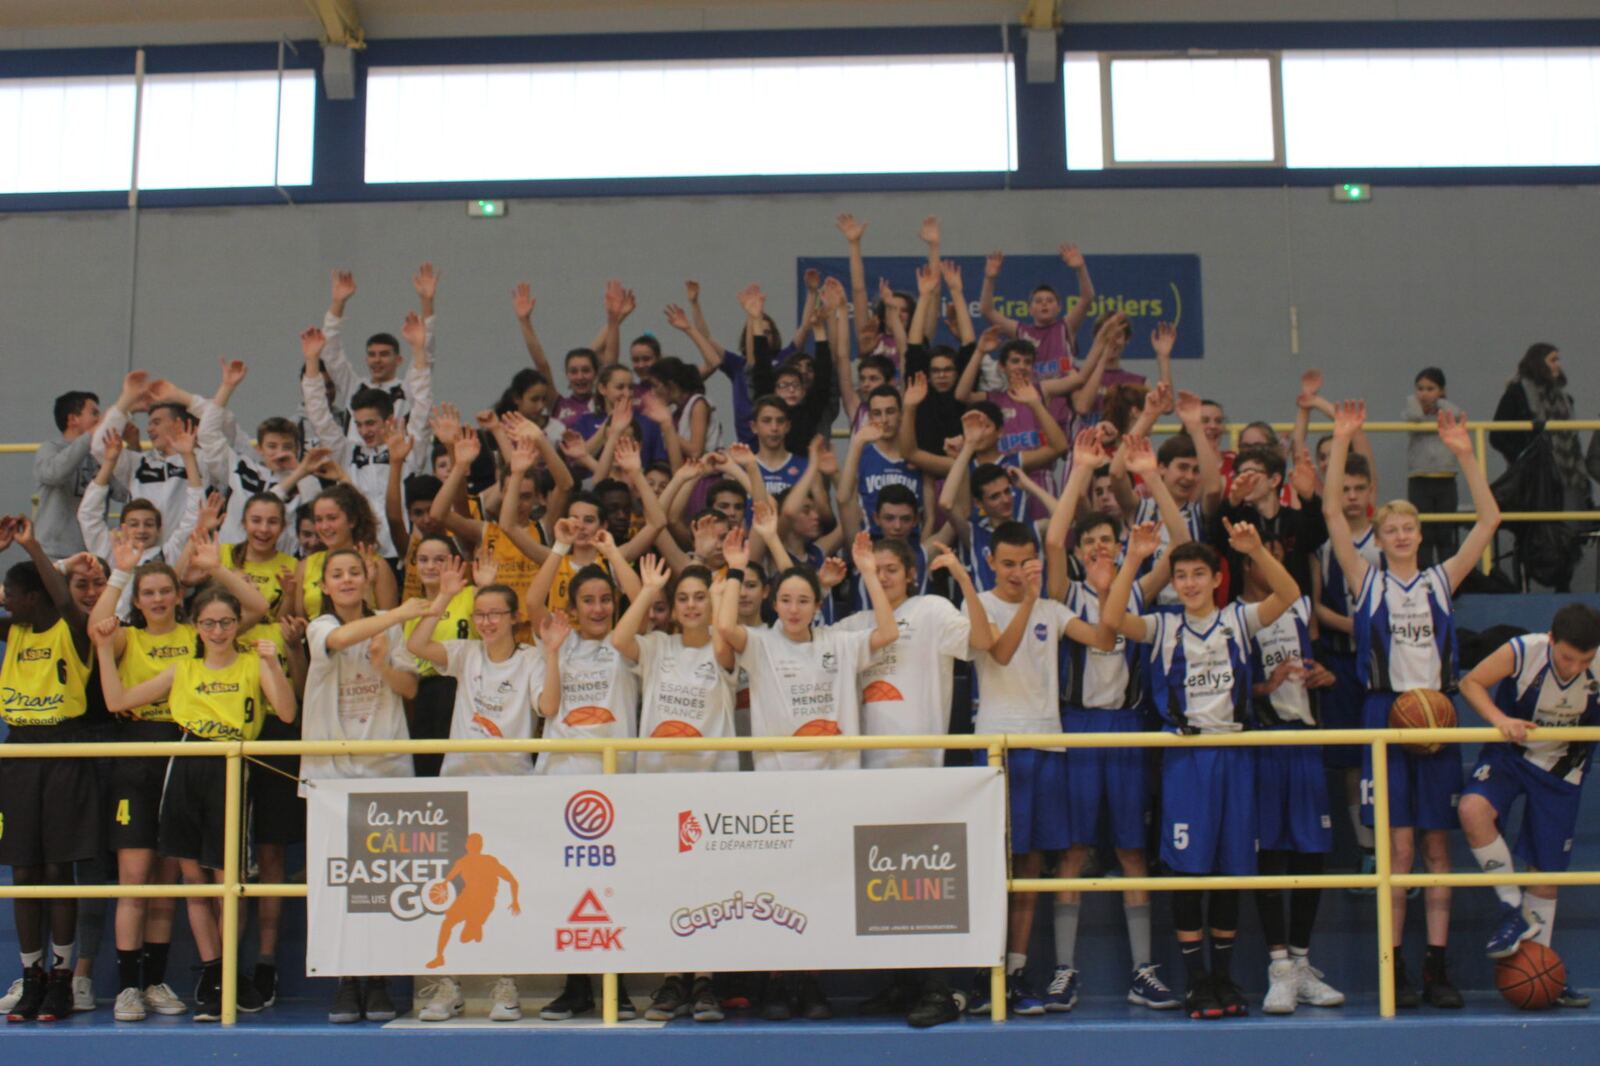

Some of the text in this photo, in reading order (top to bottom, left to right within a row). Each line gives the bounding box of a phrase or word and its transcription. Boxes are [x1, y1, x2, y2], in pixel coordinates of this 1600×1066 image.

[57, 658, 67, 685] 6
[1184, 670, 1232, 689] ealys
[660, 682, 707, 698] ESPACE
[244, 697, 255, 724] 9
[657, 704, 704, 720] FRANCE
[1472, 764, 1492, 781] 4
[115, 799, 130, 826] 4
[367, 801, 449, 826] la mie
[704, 809, 795, 835] VENDÉE
[366, 827, 449, 853] CÂLINE
[705, 838, 795, 851] LE DÉPARTEMENT
[1173, 823, 1189, 850] 5
[564, 844, 617, 867] FFBB
[868, 844, 957, 872] la mie
[329, 858, 449, 884] BASKET
[371, 894, 387, 904] U15
[390, 879, 457, 920] GO
[866, 874, 956, 901] CÂLINE
[670, 890, 808, 937] Capri-Sun
[555, 927, 626, 951] PEAK
